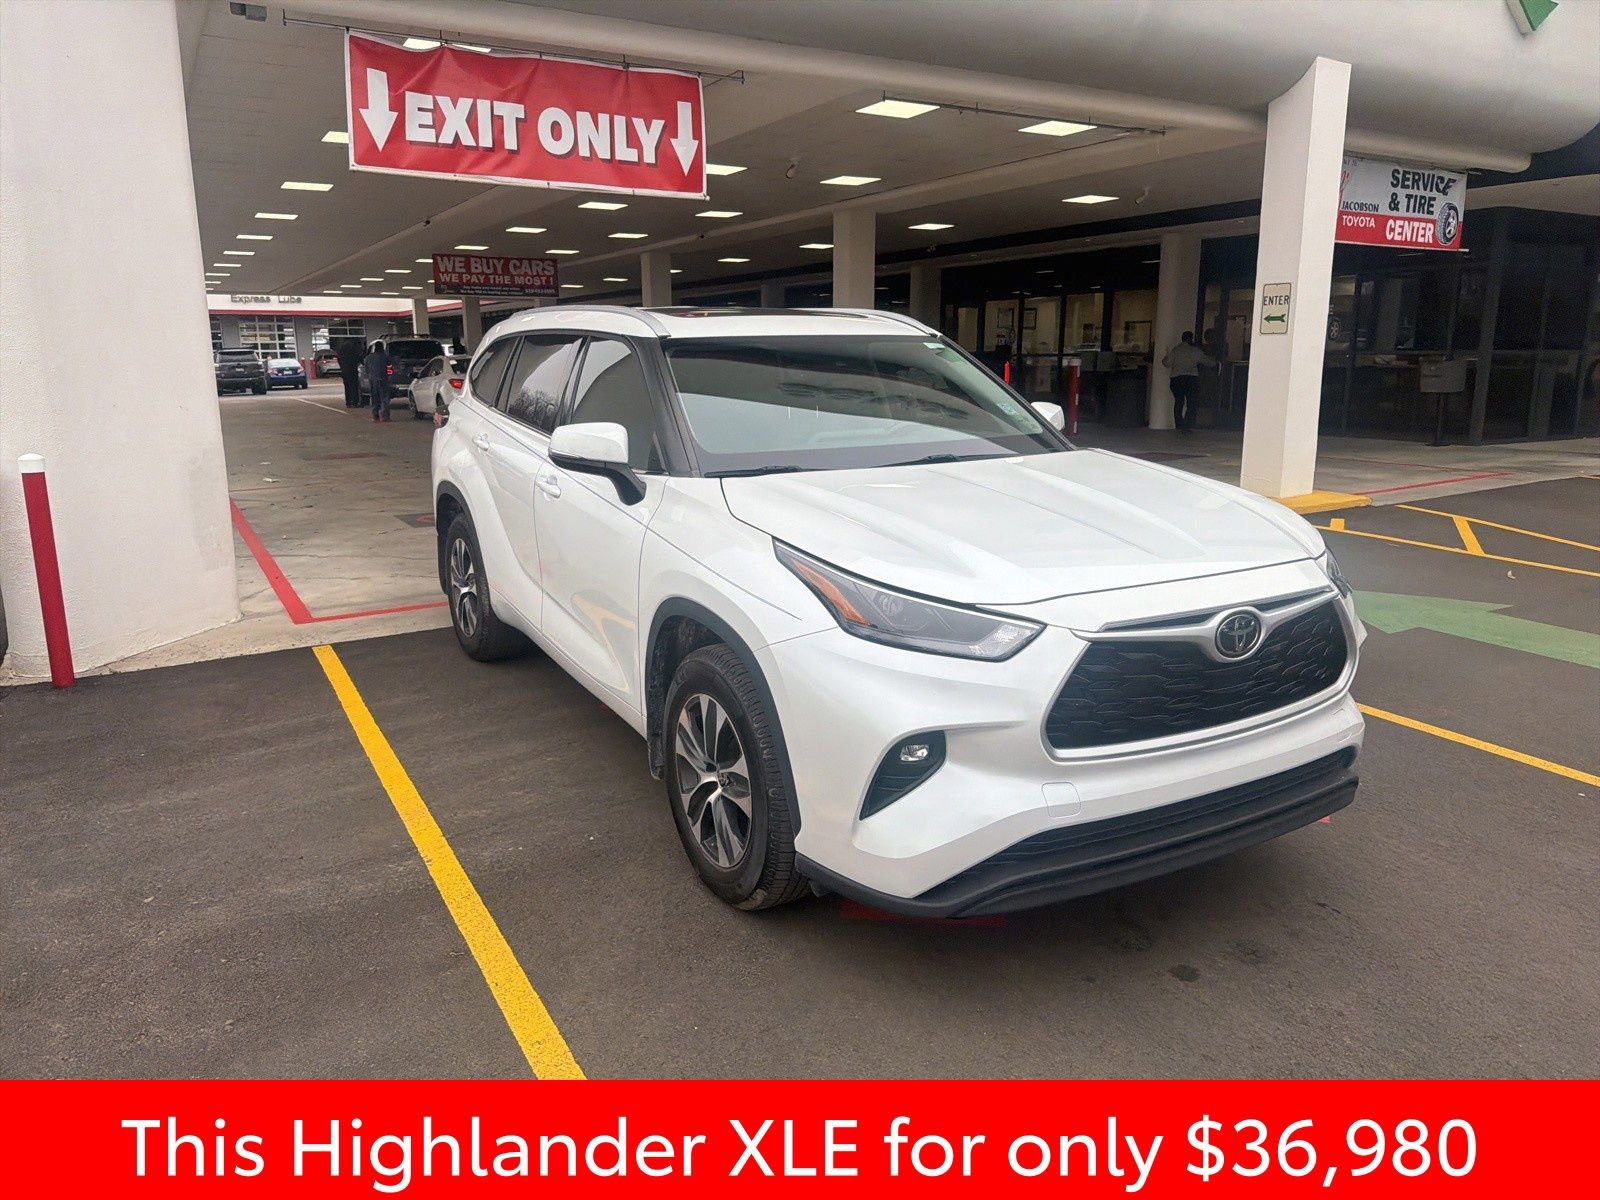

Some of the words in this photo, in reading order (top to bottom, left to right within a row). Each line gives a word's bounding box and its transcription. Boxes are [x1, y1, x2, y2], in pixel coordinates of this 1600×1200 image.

[405, 90, 526, 152] EXIT
[537, 106, 666, 165] ONLY
[1390, 168, 1457, 196] SERVICE
[1341, 200, 1380, 212] JACOBSON
[1388, 192, 1400, 212] &
[1405, 193, 1437, 215] TIRE
[1342, 215, 1376, 228] TOYOTA
[1385, 219, 1434, 244] CENTER
[436, 255, 466, 272] WE
[470, 257, 503, 273] BUY
[509, 259, 555, 276] CARS
[440, 273, 459, 283] WE
[463, 273, 484, 284] PAY
[489, 275, 511, 285] THE
[514, 276, 547, 286] MOST
[230, 294, 271, 304] Express
[278, 295, 303, 304] Lube
[1263, 295, 1290, 306] ENTER
